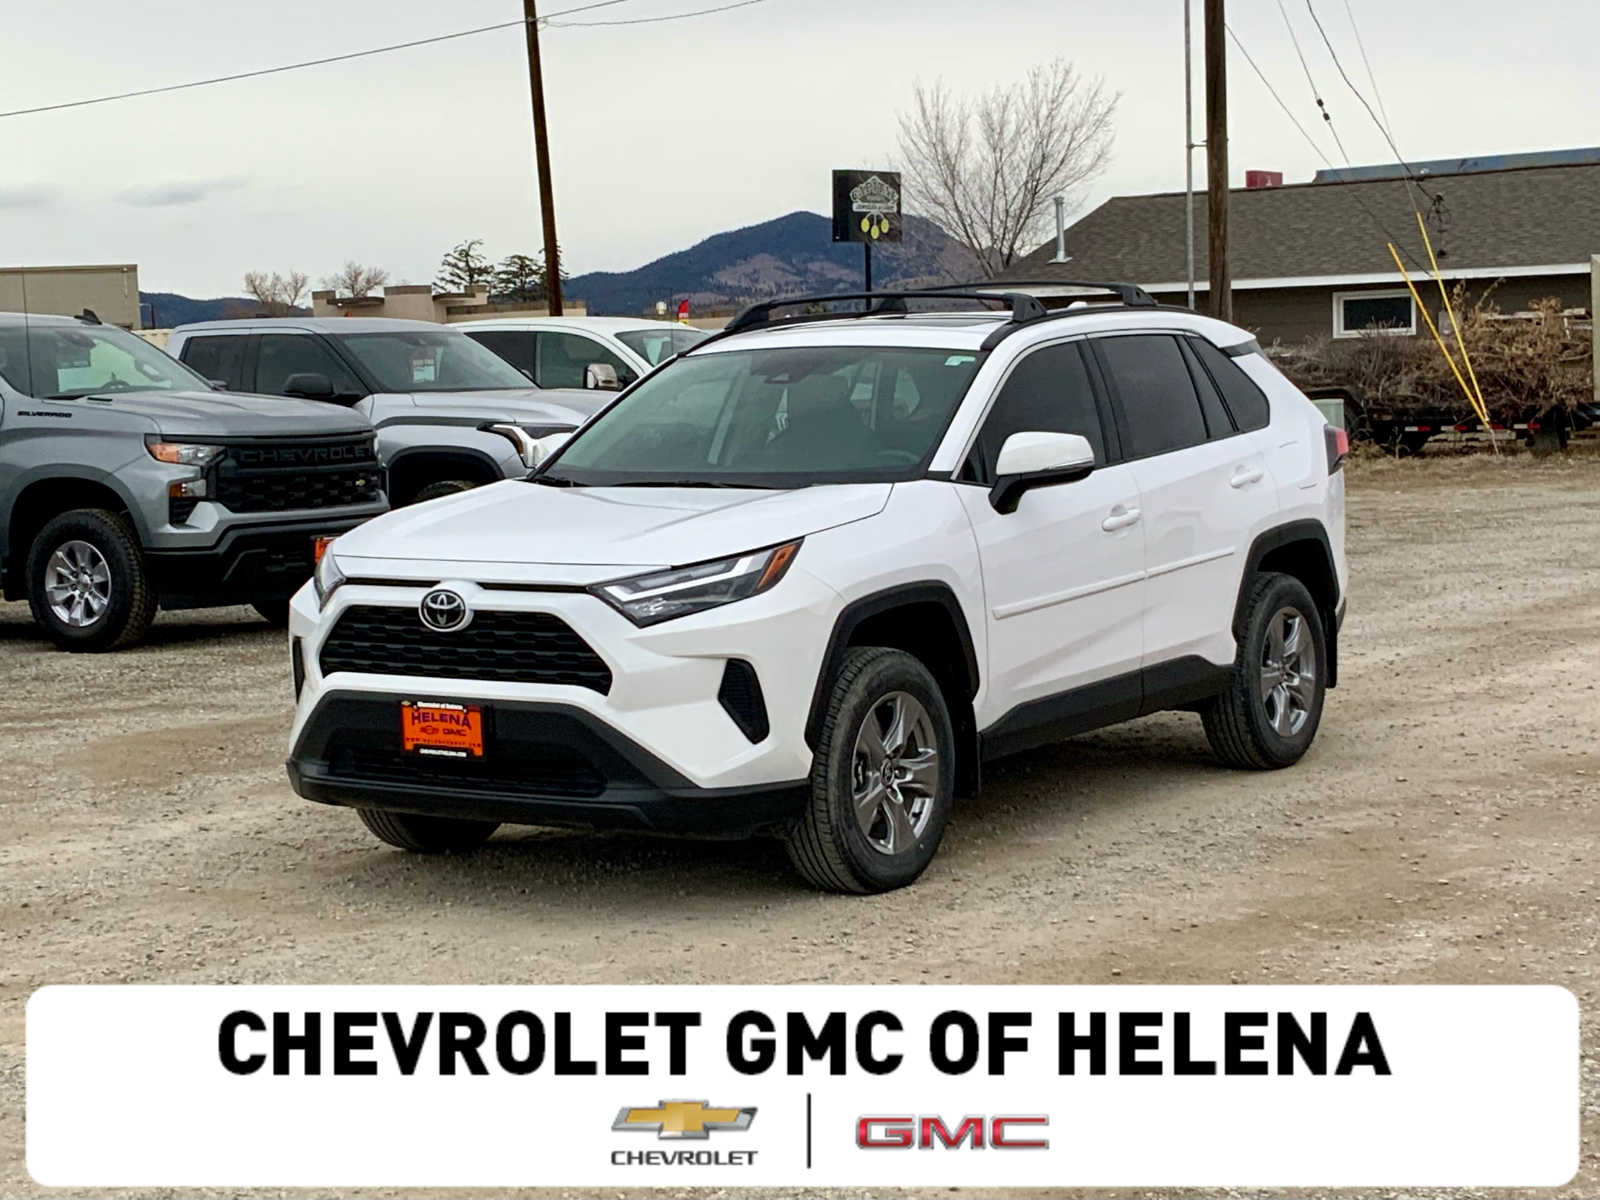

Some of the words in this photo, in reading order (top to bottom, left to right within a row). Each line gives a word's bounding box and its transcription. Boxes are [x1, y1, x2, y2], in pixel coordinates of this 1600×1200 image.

[17, 410, 73, 418] SILVERADO
[240, 444, 373, 462] CHEVROLET
[412, 712, 472, 731] HELENA
[443, 728, 467, 737] GMC
